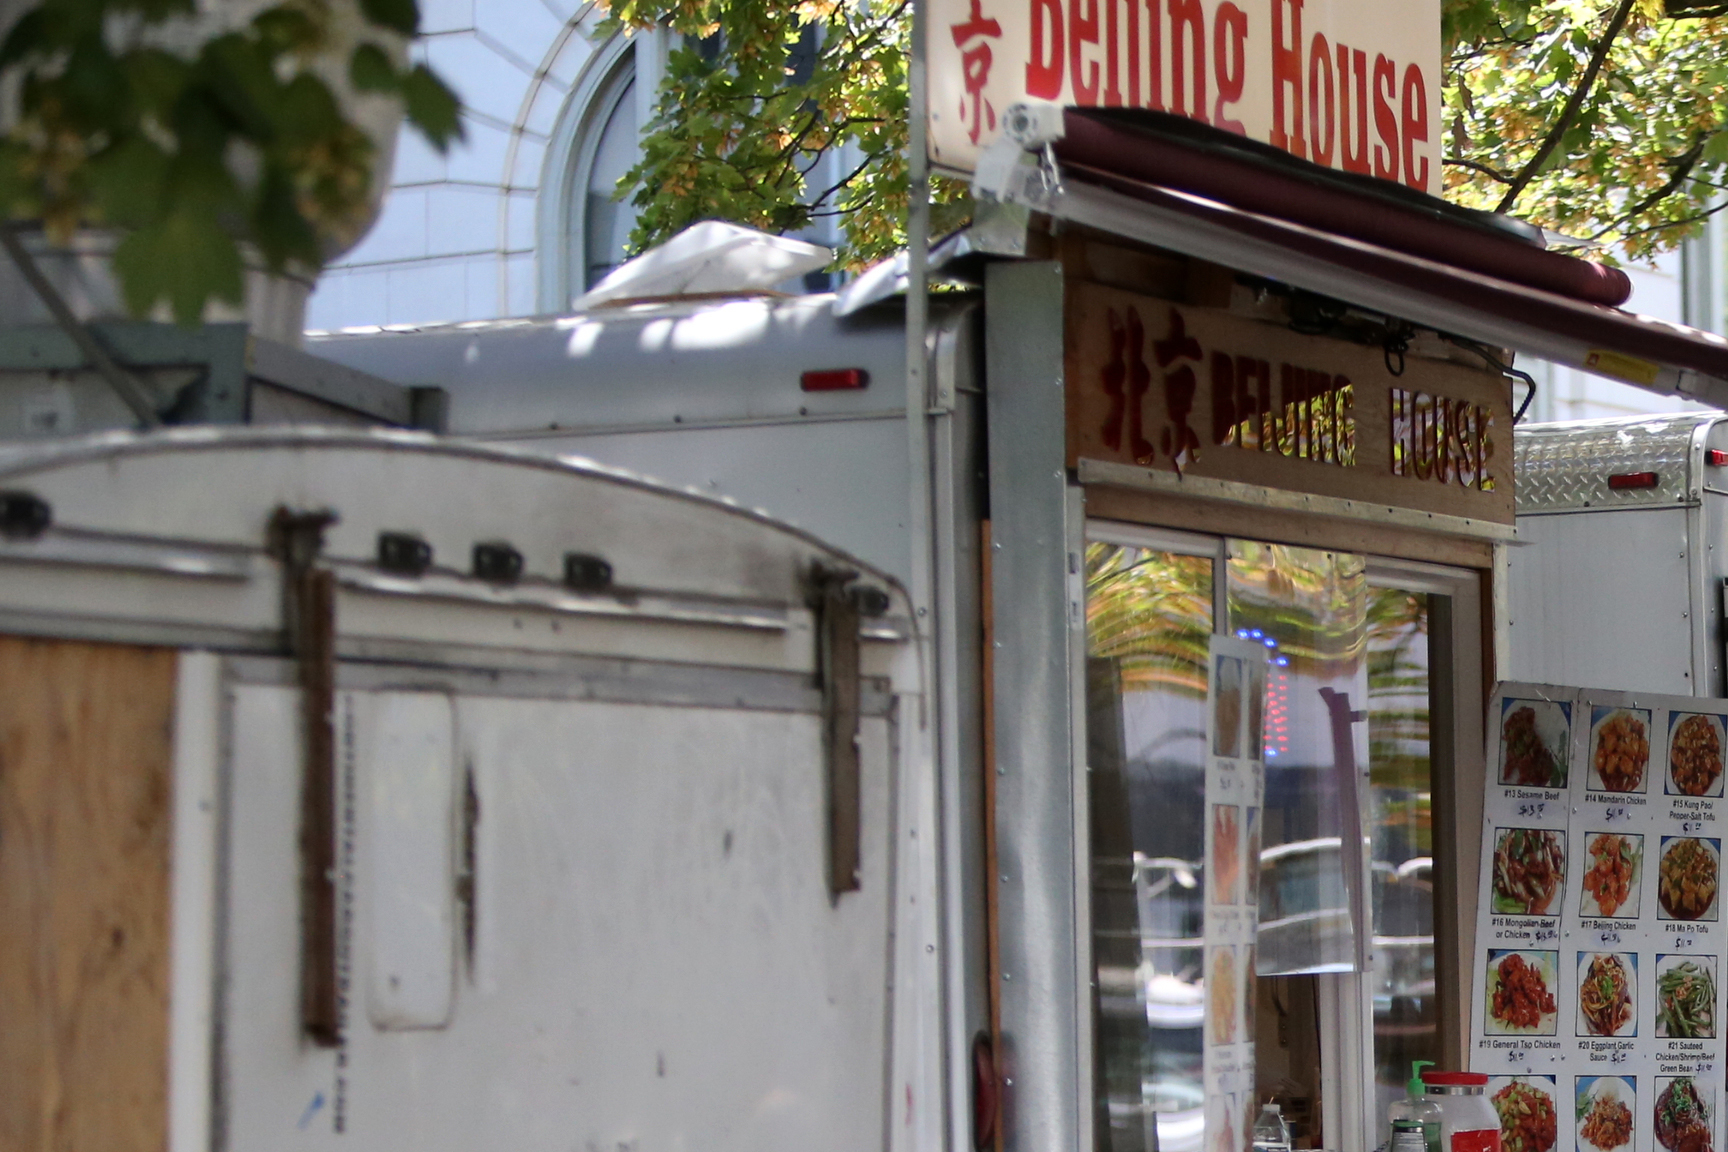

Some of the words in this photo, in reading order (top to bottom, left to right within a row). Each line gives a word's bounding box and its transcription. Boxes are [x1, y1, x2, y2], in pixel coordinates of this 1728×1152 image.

[1270, 0, 1428, 192] House
[1100, 306, 1203, 480] 北京
[1211, 350, 1356, 467] BEIJING
[1390, 387, 1495, 492] HOUSE
[1504, 790, 1516, 798] #13
[1517, 791, 1542, 799] Sesame
[1544, 792, 1559, 800] Beef
[1585, 794, 1597, 802] #14
[1598, 794, 1625, 804] Mandarin
[1627, 797, 1646, 805] Chicken
[1673, 800, 1682, 808] #15
[1683, 800, 1697, 810] Kung
[1670, 811, 1701, 821] Pepper-Salt
[1703, 812, 1715, 821] Tofu
[1492, 917, 1504, 926] #16
[1582, 921, 1592, 929] #17
[1593, 921, 1613, 931] Beijing
[1614, 922, 1636, 930] Chicken
[1666, 924, 1676, 932] #18
[1696, 925, 1708, 933] Tofu
[1496, 931, 1503, 939] or
[1505, 930, 1531, 939] Chicken
[1479, 1040, 1491, 1049] #19
[1493, 1040, 1519, 1049] General
[1520, 1041, 1532, 1049] Tso
[1534, 1041, 1560, 1049] Chicken
[1578, 1041, 1590, 1049] #20
[1591, 1041, 1615, 1051] Eggplant
[1590, 1053, 1607, 1061] Sauce
[1655, 1053, 1715, 1062] Chicken/Shrimp/Beef
